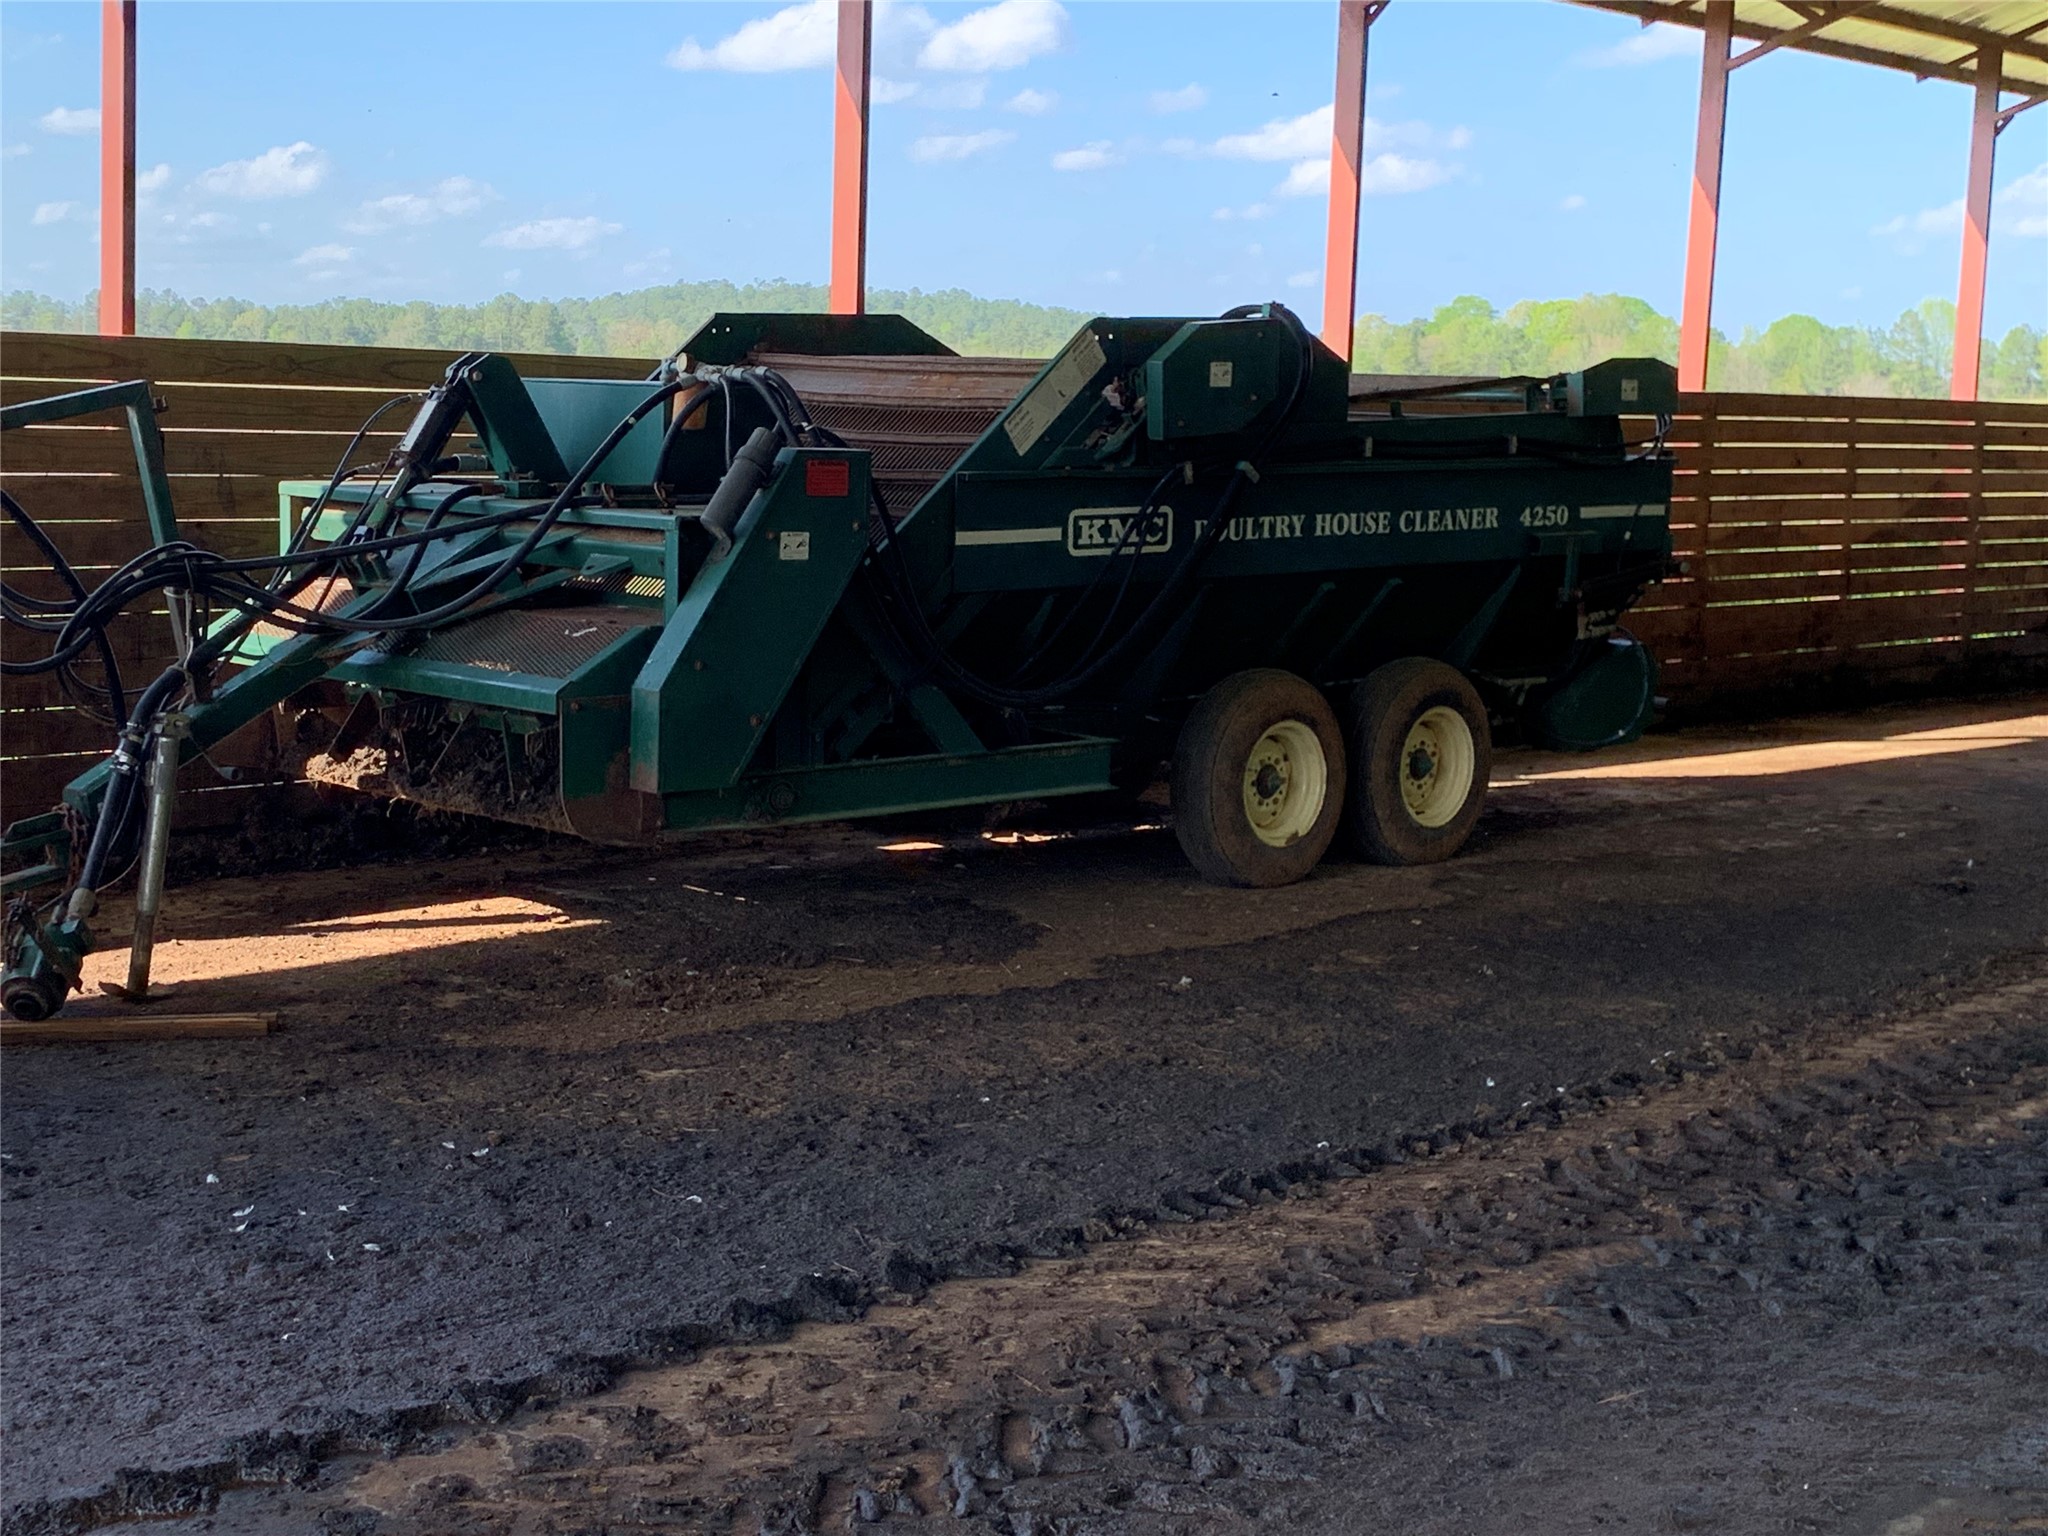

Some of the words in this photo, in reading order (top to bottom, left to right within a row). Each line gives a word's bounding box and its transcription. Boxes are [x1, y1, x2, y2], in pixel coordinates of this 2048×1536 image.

[1314, 511, 1391, 537] HOUSE
[1399, 506, 1499, 533] CLEANER
[1519, 505, 1569, 528] 4250
